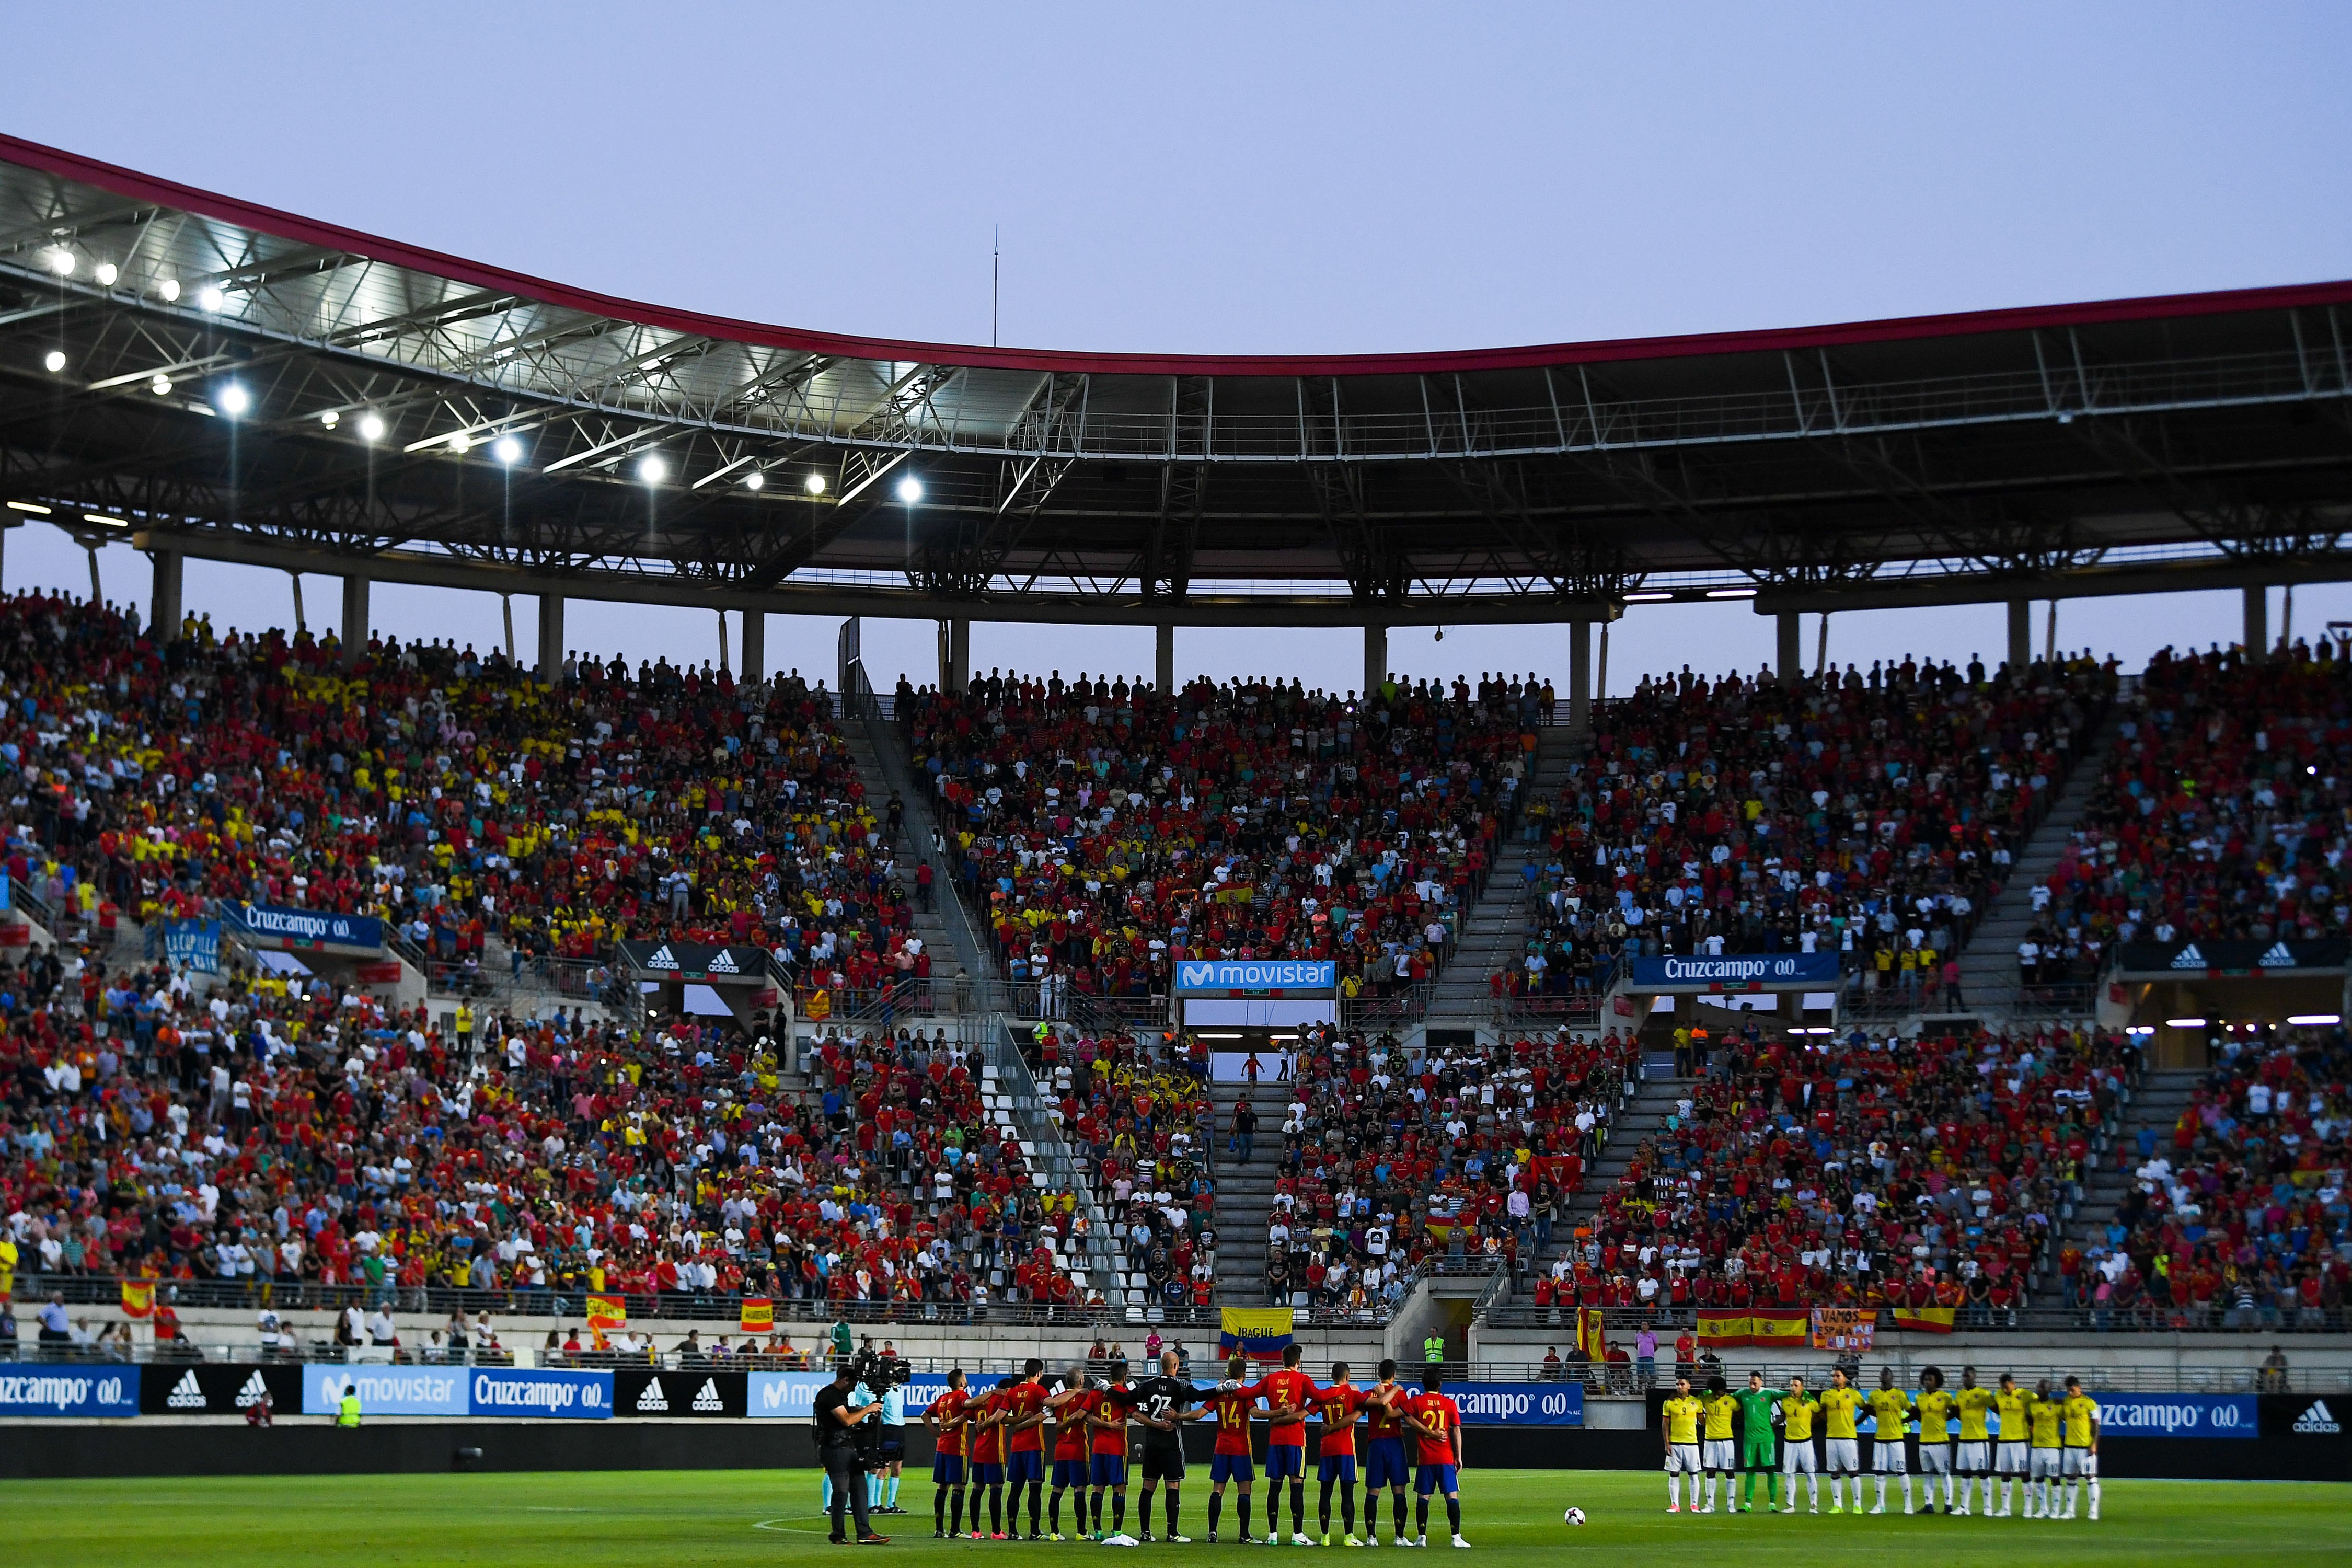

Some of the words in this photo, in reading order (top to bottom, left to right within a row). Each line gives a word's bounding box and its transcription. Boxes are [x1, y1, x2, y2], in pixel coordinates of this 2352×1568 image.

[247, 905, 326, 938] Cruzcampo
[647, 959, 679, 970] adidas
[708, 963, 740, 973] adidas
[1220, 964, 1330, 983] movistar
[1665, 959, 1765, 980] Cruzcampo
[1821, 1309, 1859, 1323] VAMOS
[1238, 1327, 1273, 1338] IBAGUE
[357, 1375, 455, 1402] movistar
[475, 1375, 574, 1412] Cruzcampo
[167, 1393, 207, 1407] adidas
[637, 1398, 668, 1410] adidas
[692, 1398, 723, 1410] adidas
[1150, 1394, 1171, 1422] 23
[1542, 1393, 1566, 1416] 0,0
[1219, 1401, 1241, 1429] 14
[1325, 1403, 1344, 1424] 17
[1682, 1406, 1687, 1416] 9
[1423, 1410, 1445, 1438] 21
[2292, 1421, 2340, 1432] adidas
